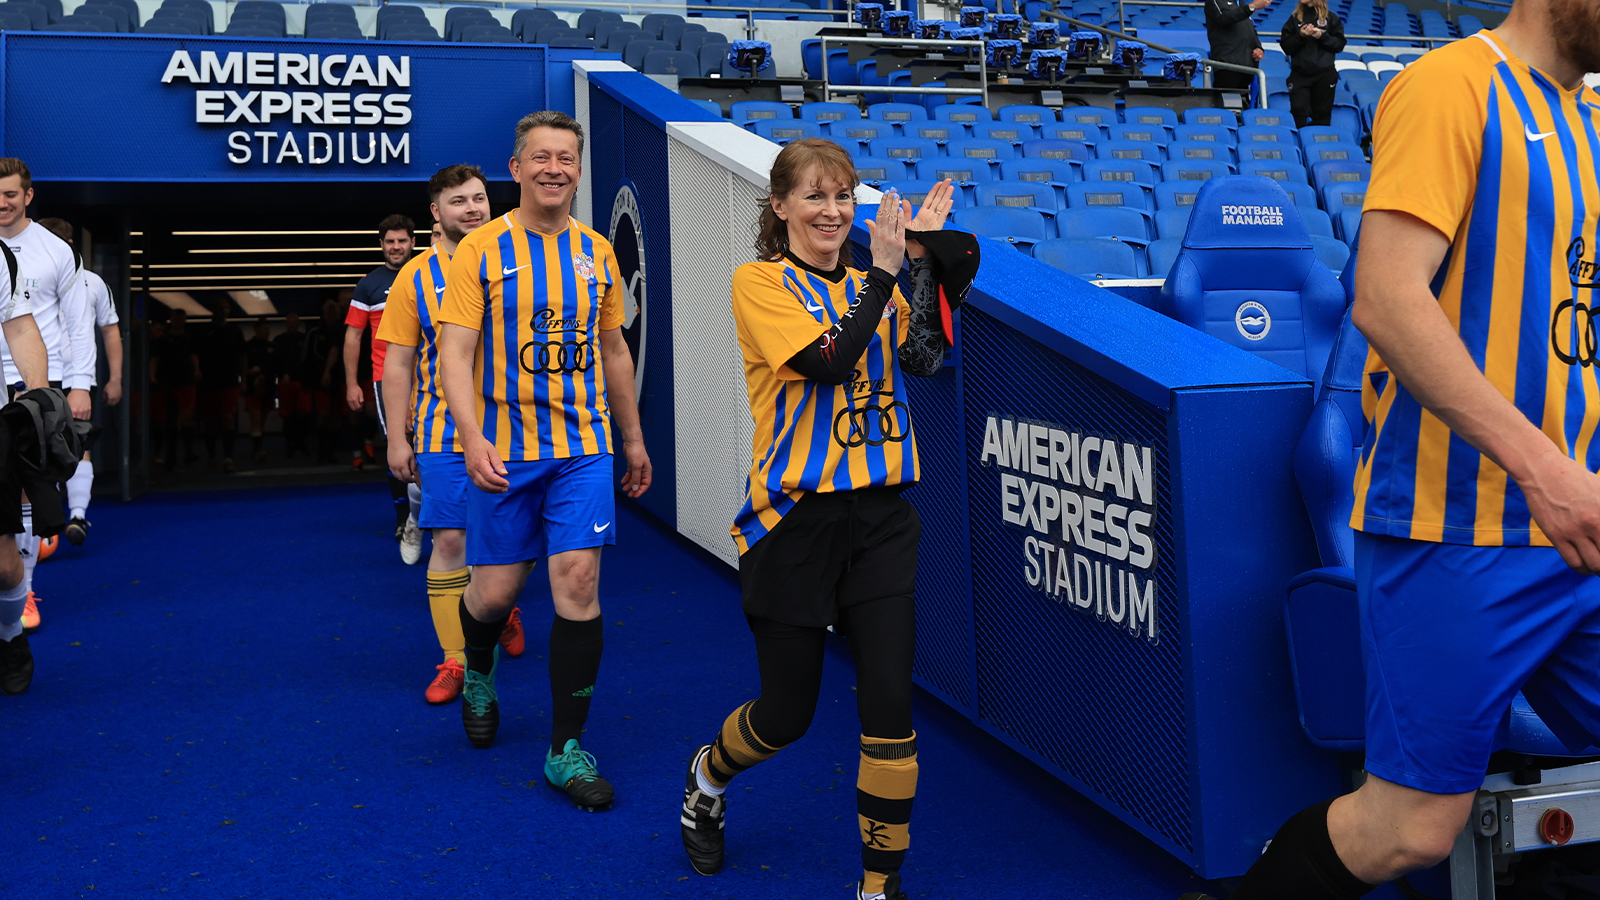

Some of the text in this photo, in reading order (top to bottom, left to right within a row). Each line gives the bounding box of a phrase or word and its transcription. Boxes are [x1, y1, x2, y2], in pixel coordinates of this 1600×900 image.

[161, 50, 410, 87] AMERICAN
[196, 90, 412, 125] EXPRESS
[228, 131, 410, 164] STADIUM
[1222, 205, 1283, 216] FOOTBALL
[1222, 215, 1284, 226] MANAGER
[1566, 236, 1600, 288] CAFFY
[530, 308, 588, 336] CAFFYNS
[981, 416, 1153, 506] AMERICAN
[1001, 472, 1154, 570] EXPRESS
[1024, 535, 1154, 638] STADIUM
